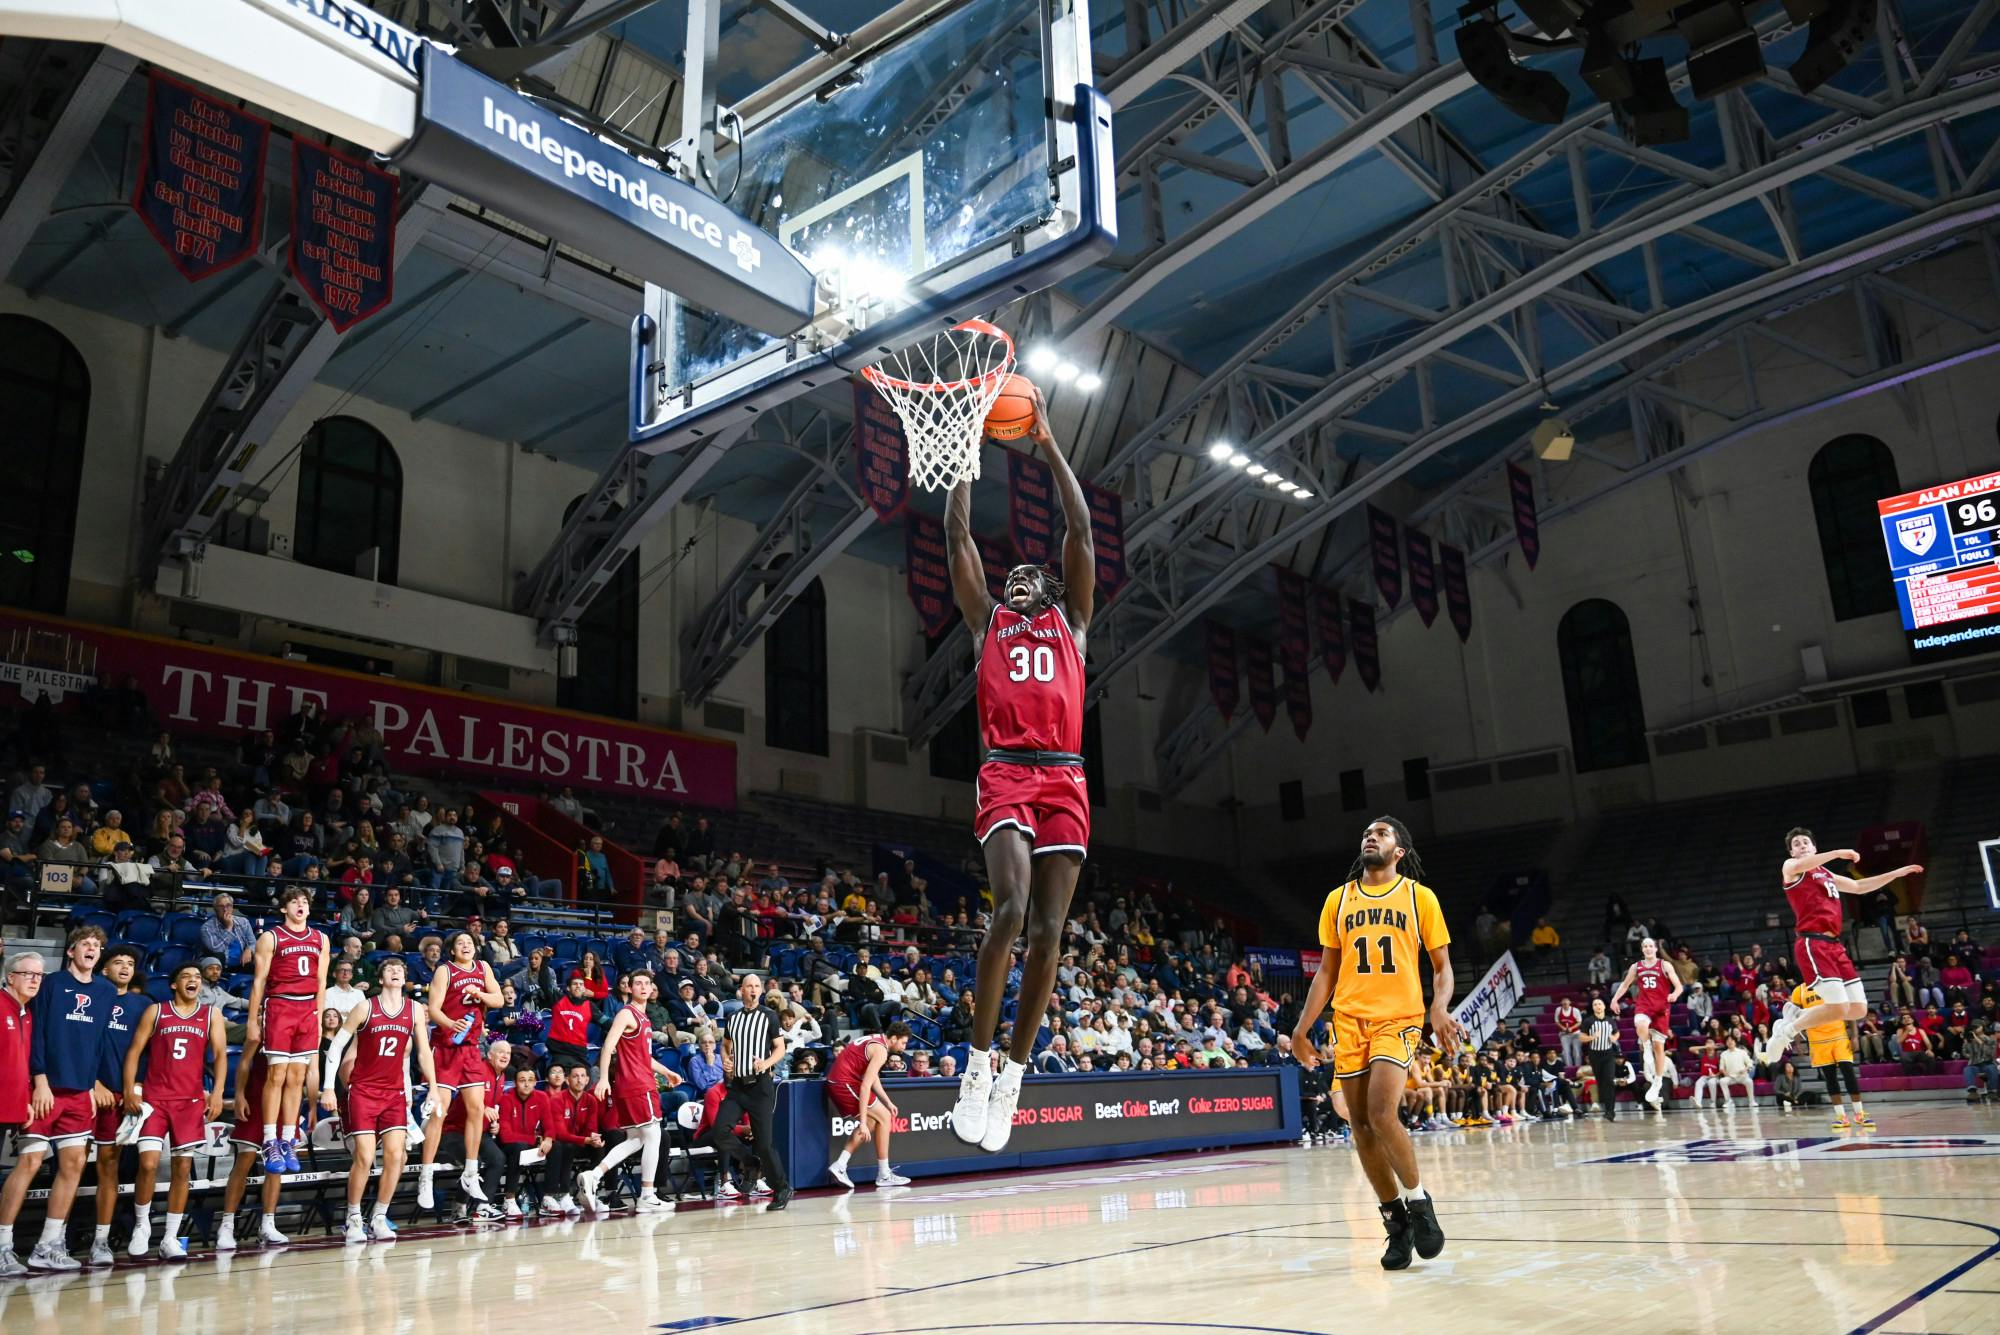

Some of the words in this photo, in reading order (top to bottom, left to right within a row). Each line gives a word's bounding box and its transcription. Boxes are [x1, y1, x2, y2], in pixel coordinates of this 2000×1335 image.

[175, 108, 243, 152] Basketball
[170, 128, 192, 153] Ivy
[196, 141, 243, 173] League
[170, 147, 239, 190] Champions
[483, 96, 722, 248] Independence
[183, 174, 220, 204] NCAA
[315, 169, 376, 208] Basketball
[154, 180, 184, 208] East
[189, 196, 244, 233] Regional
[312, 190, 333, 211] Ivy
[336, 198, 376, 225] League
[173, 207, 221, 241] Finalist
[312, 208, 375, 242] Champions
[175, 230, 216, 264] 1971
[327, 230, 360, 256] NCAA
[323, 284, 361, 314] 1972
[1918, 485, 1960, 504] ALAN
[1958, 499, 1997, 526] 96
[1963, 536, 1981, 546] TOL
[1961, 549, 1990, 562] FOULS
[1909, 563, 1938, 575] BONUS
[1914, 625, 2000, 649] Independence
[0, 665, 21, 680] HE
[1009, 646, 1055, 682] 30
[368, 699, 688, 795] PALESTRA
[46, 872, 68, 882] 103
[1824, 881, 1840, 899] 13
[659, 916, 671, 924] 103
[1345, 908, 1407, 933] ROWAN
[297, 955, 310, 976] 0
[1353, 935, 1397, 975] 11
[1461, 987, 1490, 1024] QUAKE
[1487, 963, 1509, 990] ZONE
[1642, 976, 1657, 989] 35
[73, 993, 92, 1015] P
[66, 1013, 94, 1023] BASKETBALL
[371, 1024, 409, 1035] PENNSYLVANIA
[160, 1025, 204, 1038] PENNSYLVANIA
[172, 1038, 188, 1060] 5
[378, 1036, 398, 1057] 12
[911, 1111, 953, 1131] Ever?
[1012, 1108, 1037, 1125] ERO
[1040, 1105, 1083, 1123] SUGAR
[1095, 1102, 1123, 1119] Best
[1122, 1100, 1149, 1117] Coke
[1149, 1099, 1180, 1116] Ever?
[1188, 1097, 1213, 1113] Coke
[1213, 1098, 1240, 1112] ZERO
[1241, 1096, 1274, 1110] SUGAR
